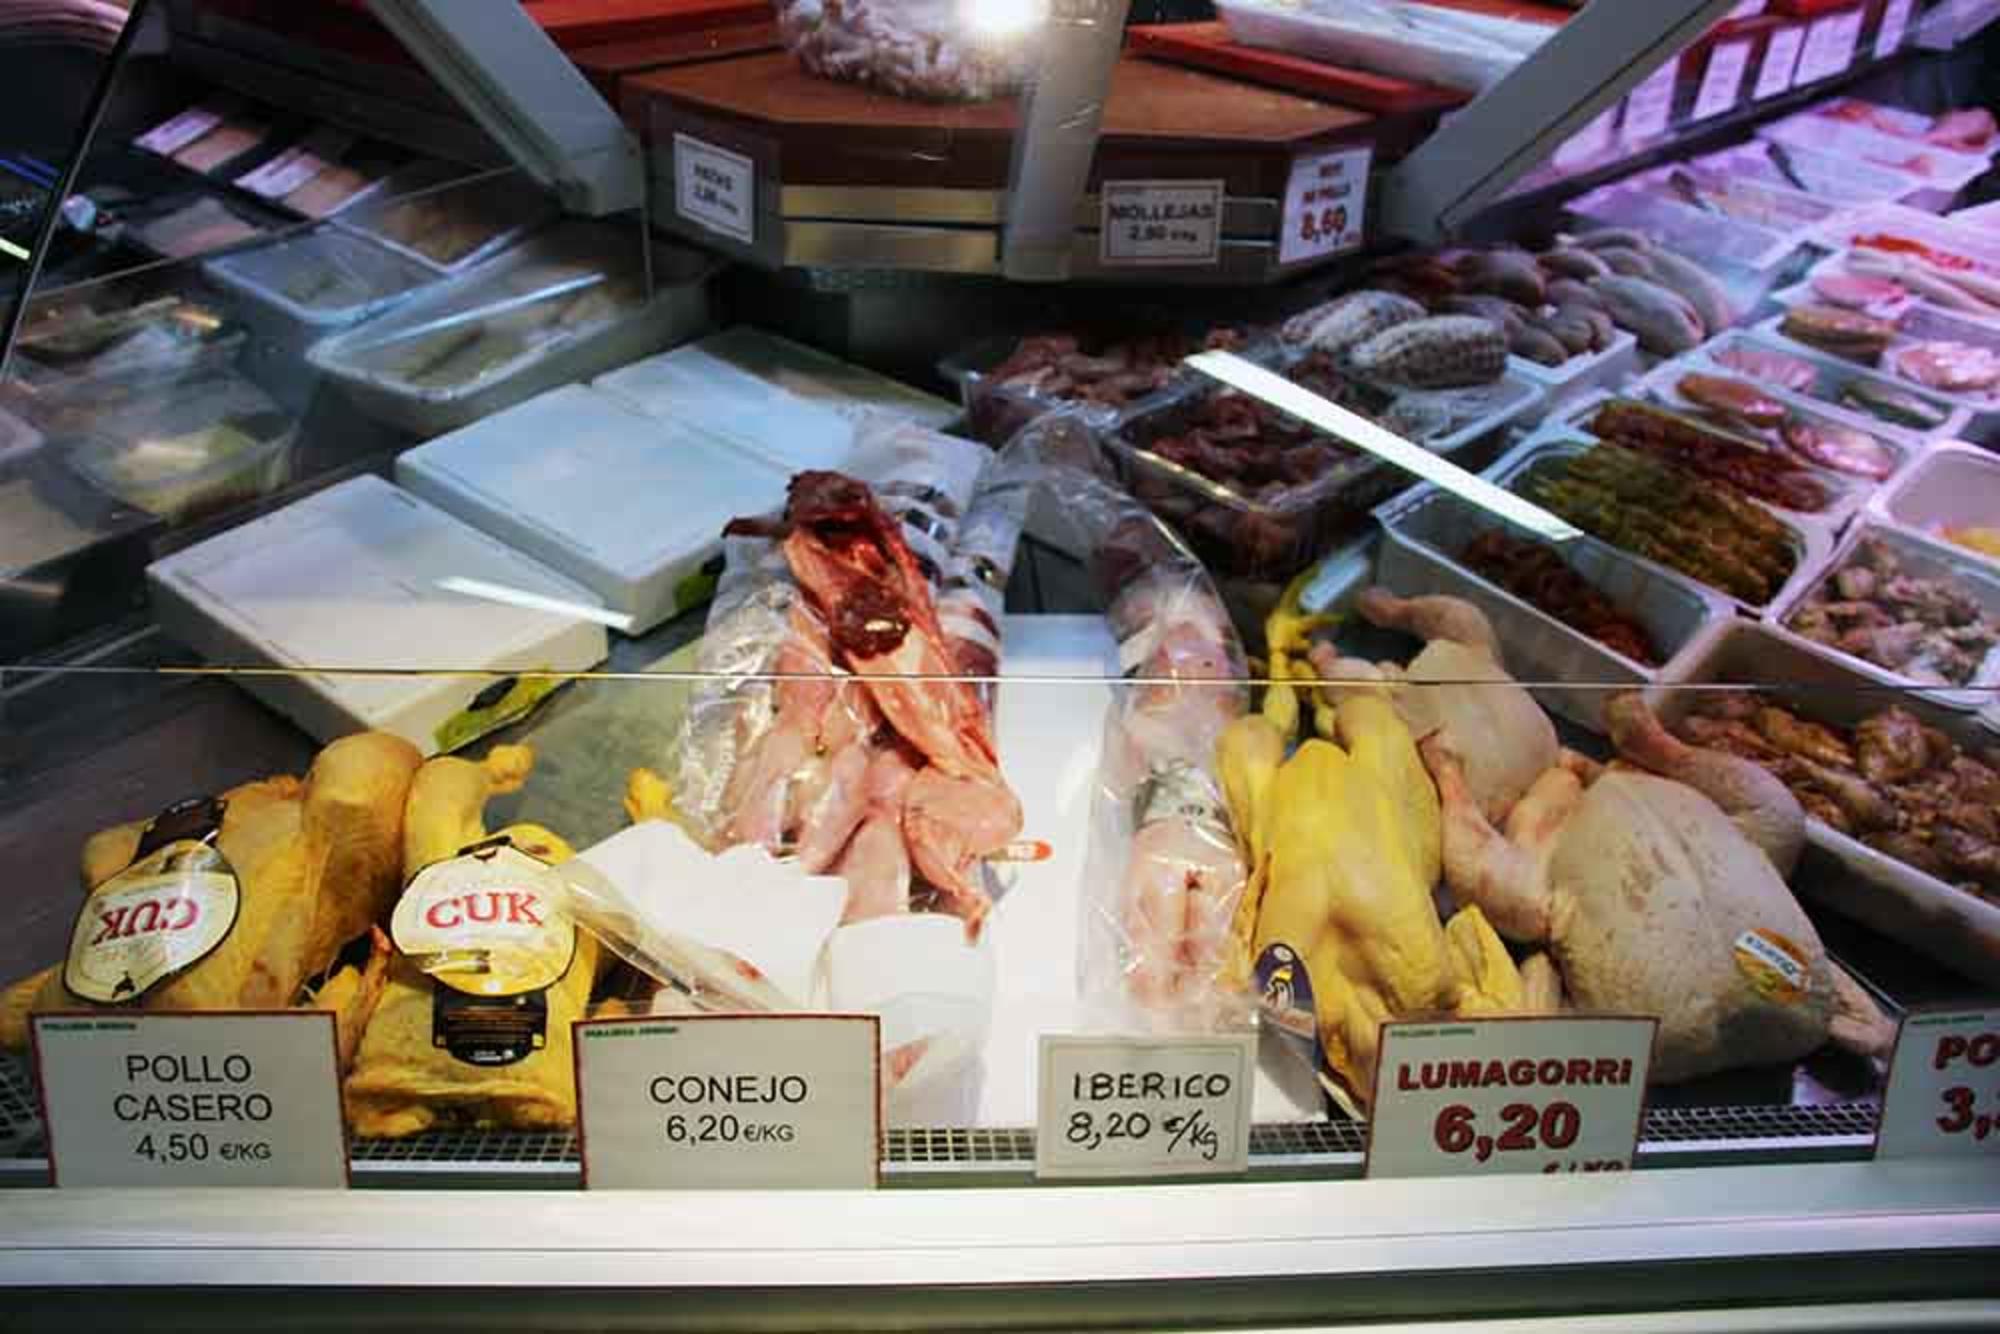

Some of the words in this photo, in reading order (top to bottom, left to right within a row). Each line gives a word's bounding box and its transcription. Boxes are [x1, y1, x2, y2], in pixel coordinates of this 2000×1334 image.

[92, 896, 200, 946] CUK
[425, 891, 543, 929] CUK
[126, 1054, 251, 1083] POLLO
[1397, 1058, 1633, 1091] LUMAGORRI
[649, 1075, 808, 1104] CONEJO
[1073, 1072, 1231, 1101] IBERICO
[113, 1094, 272, 1122] CASERO
[1936, 1086, 2000, 1141] 3,
[666, 1115, 739, 1146] 6,20
[743, 1124, 794, 1142] €/KG
[1066, 1111, 1151, 1150] 8,20
[1434, 1102, 1581, 1162] 6,20
[135, 1133, 209, 1164] 4,50
[219, 1142, 272, 1161] €/KG
